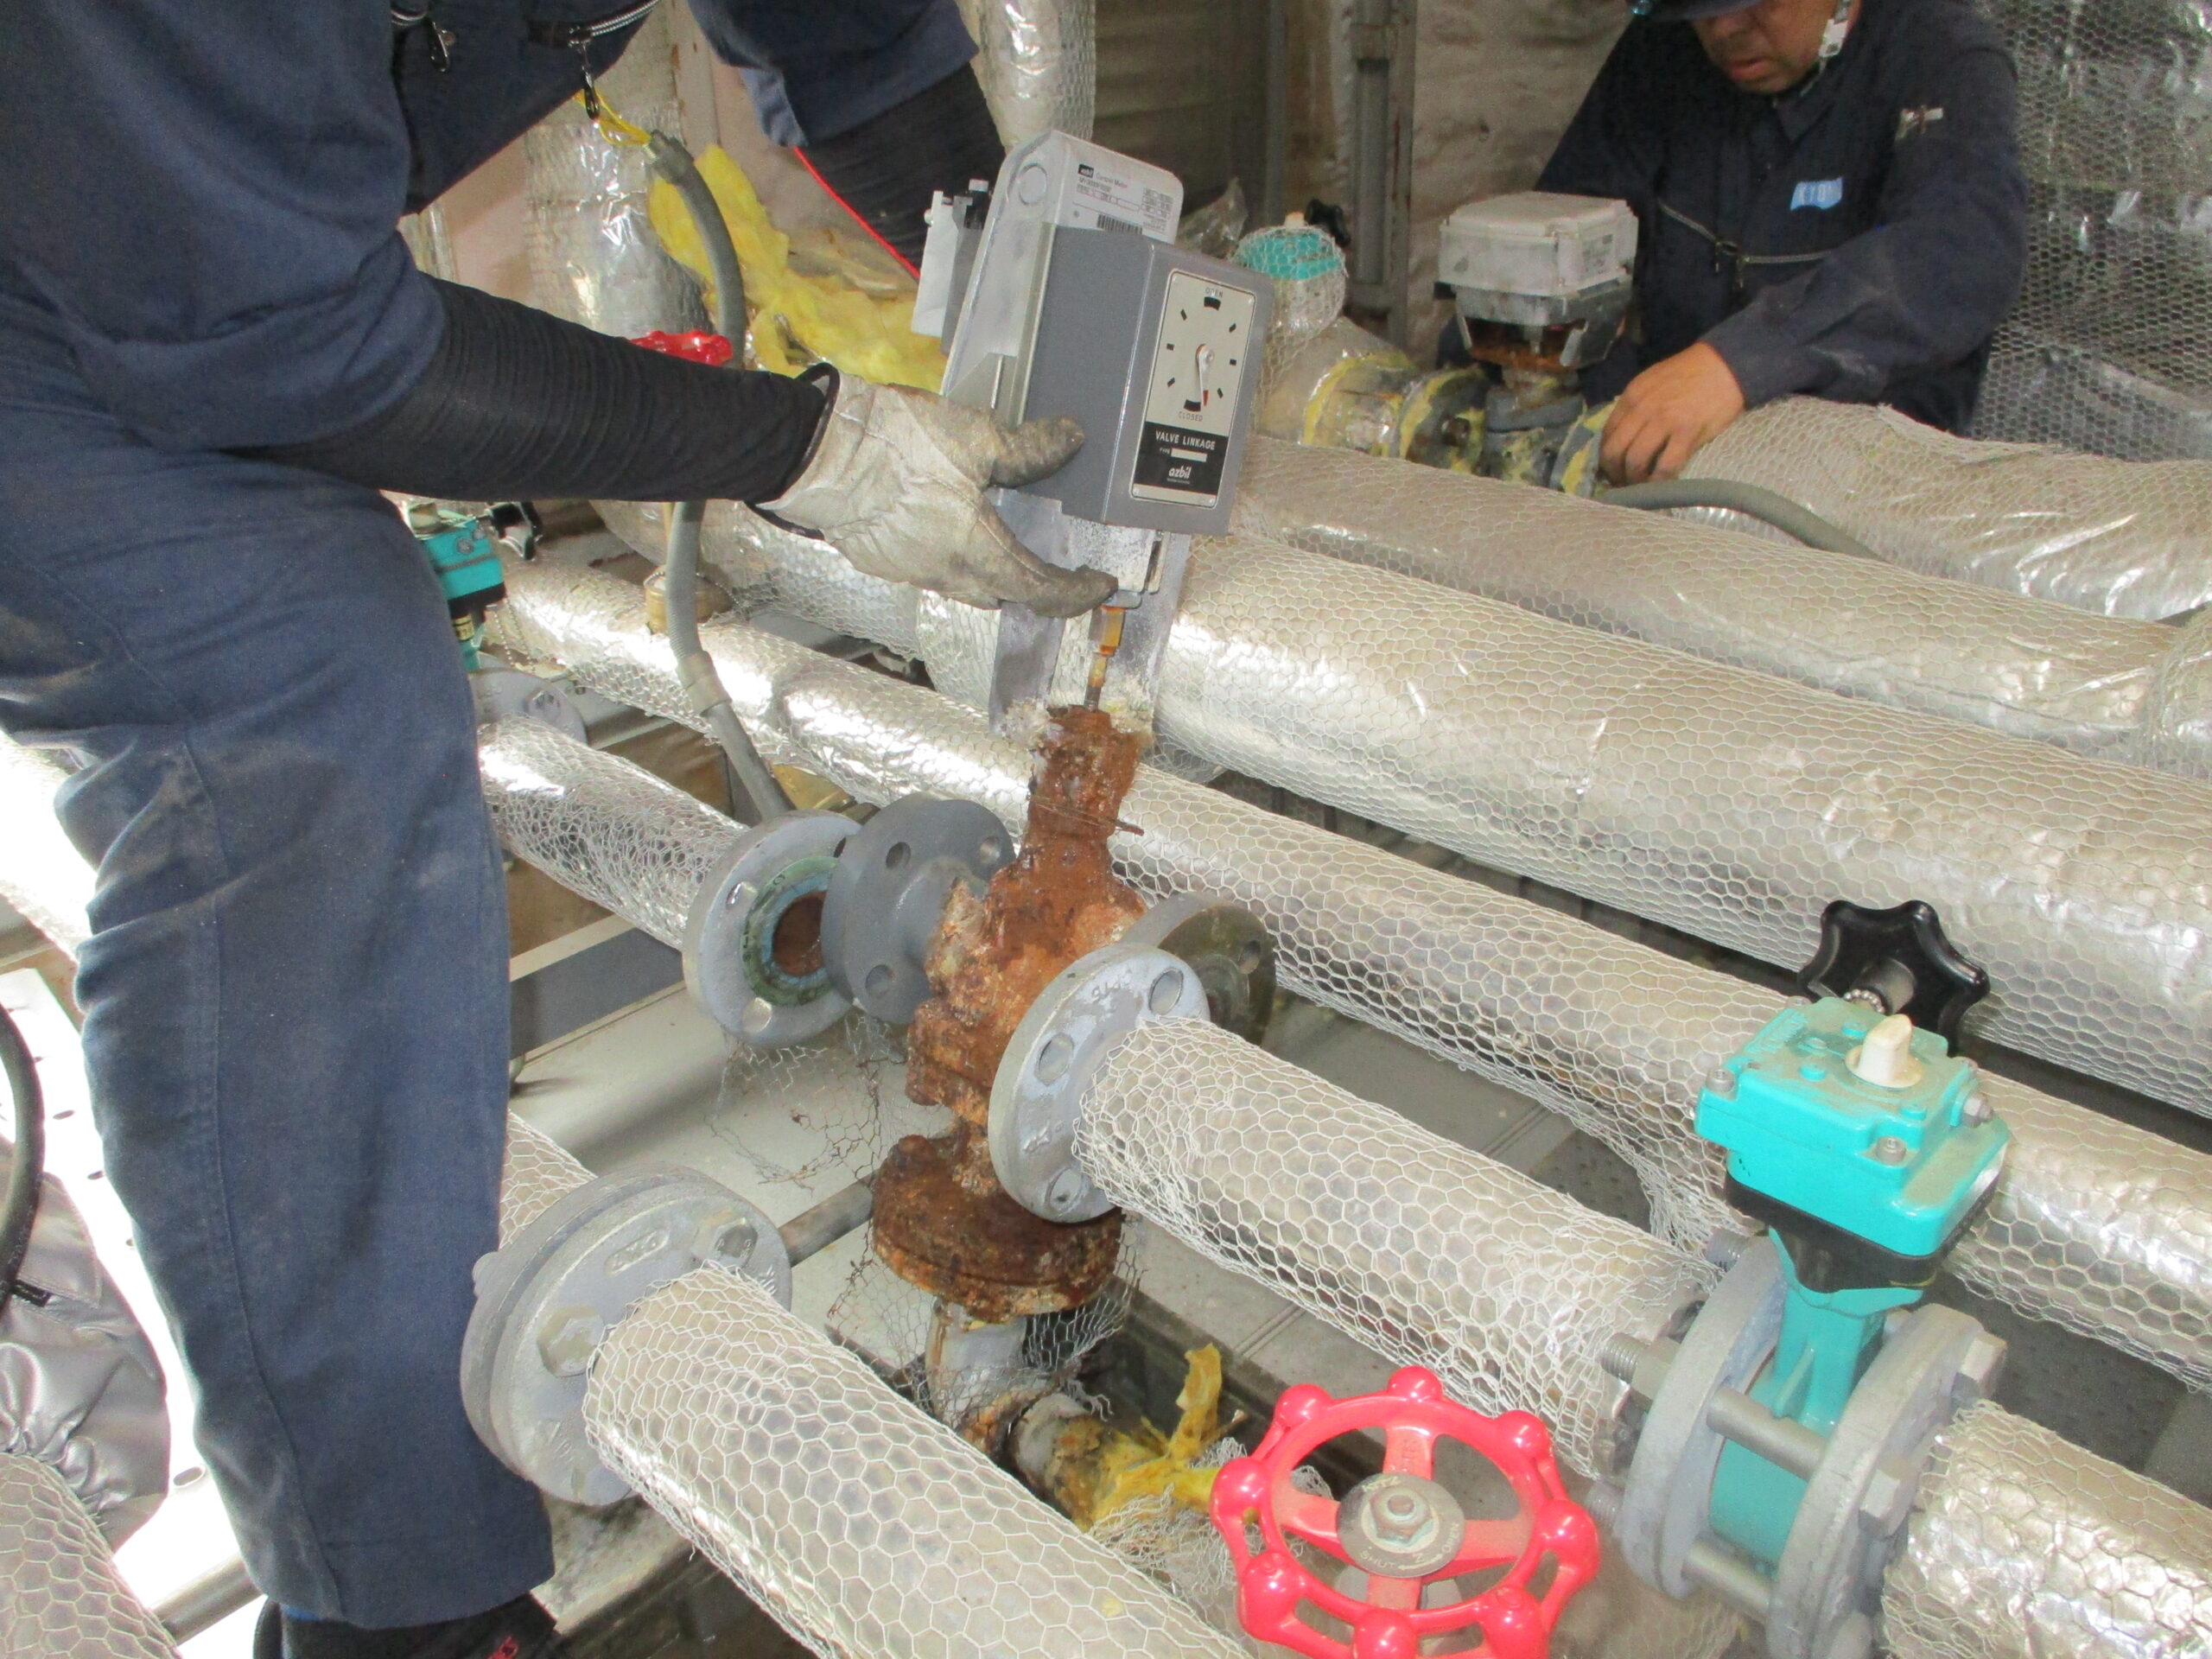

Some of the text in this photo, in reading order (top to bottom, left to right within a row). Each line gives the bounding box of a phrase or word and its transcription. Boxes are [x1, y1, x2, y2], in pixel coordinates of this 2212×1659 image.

[1205, 287, 1224, 298] OPEN
[1178, 411, 1204, 422] CLOSED
[1156, 430, 1216, 450] VALVE LINKAGE
[1168, 466, 1192, 480] azbil
[1441, 1522, 1459, 1554] OPEN
[1360, 1550, 1395, 1569] SHUT
